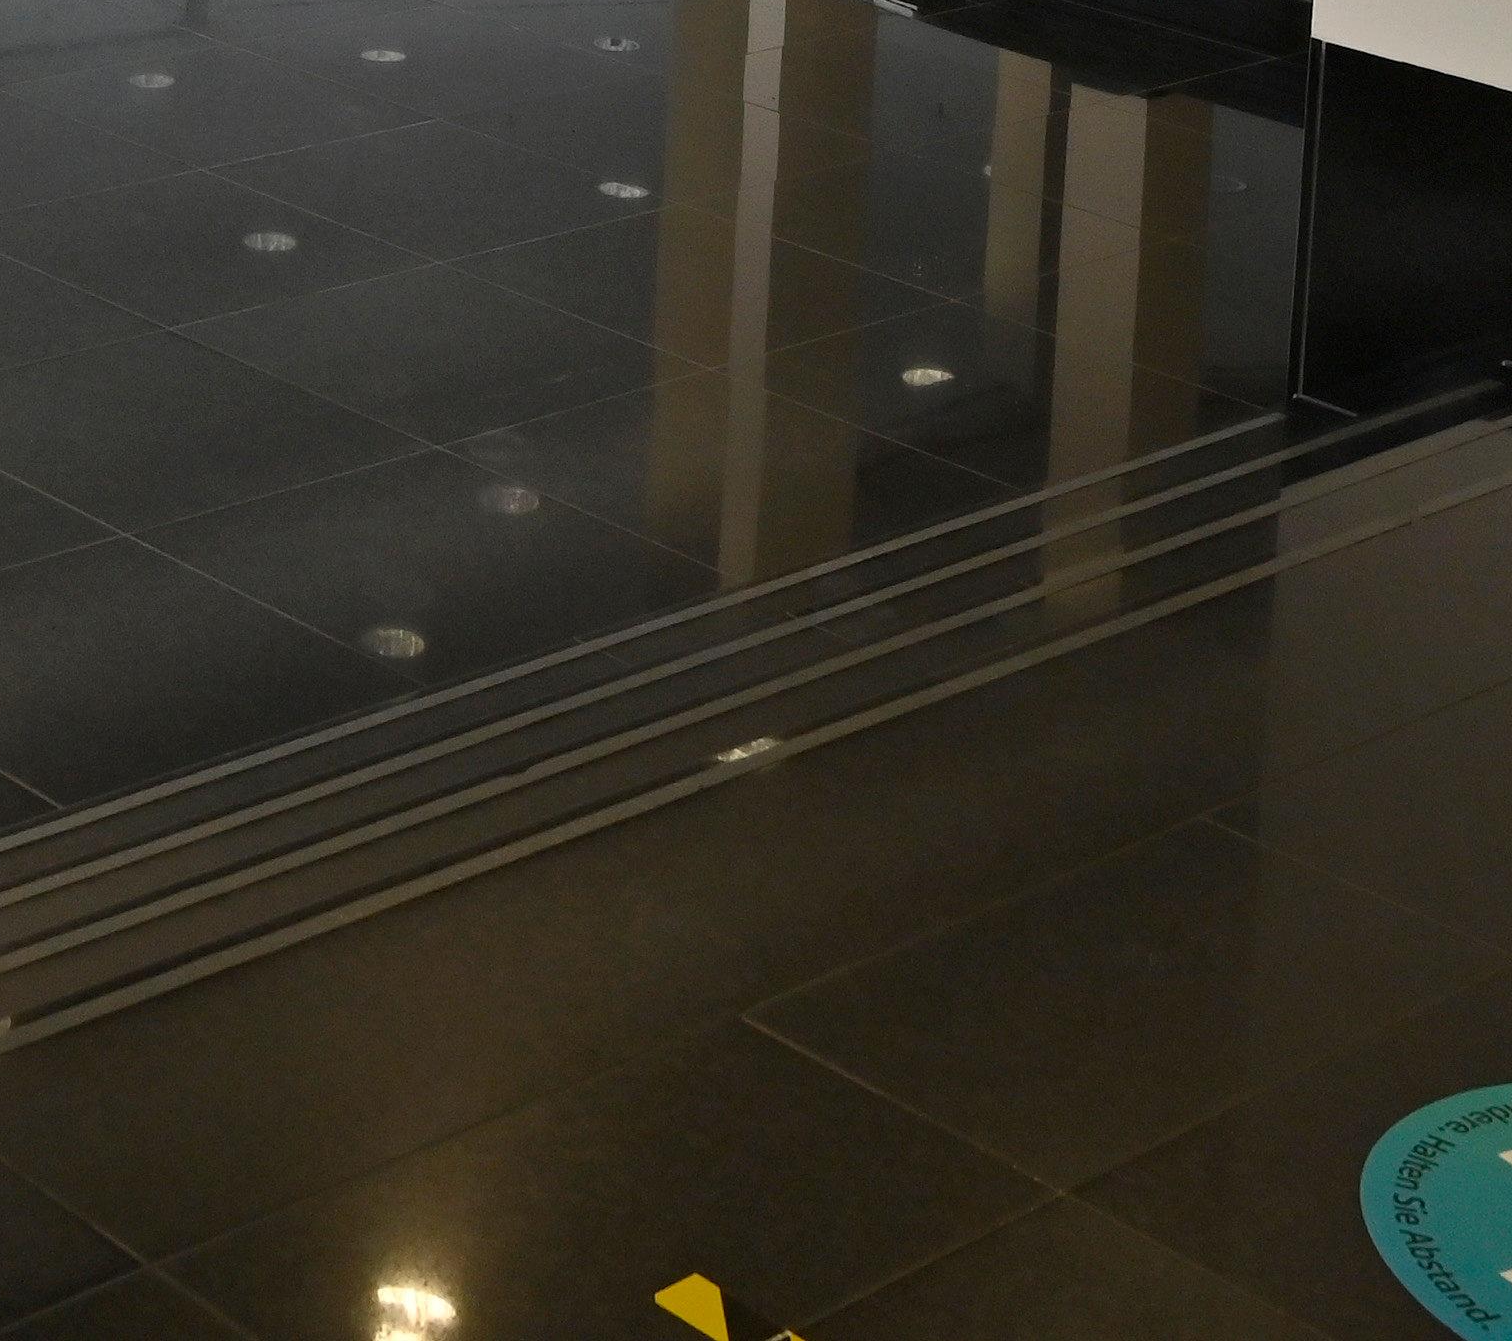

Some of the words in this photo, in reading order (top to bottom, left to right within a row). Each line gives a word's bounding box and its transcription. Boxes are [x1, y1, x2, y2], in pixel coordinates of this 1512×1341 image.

[1397, 1129, 1456, 1189] Halten
[1392, 1188, 1428, 1227] Sie
[1400, 1226, 1502, 1331] Abstand.
